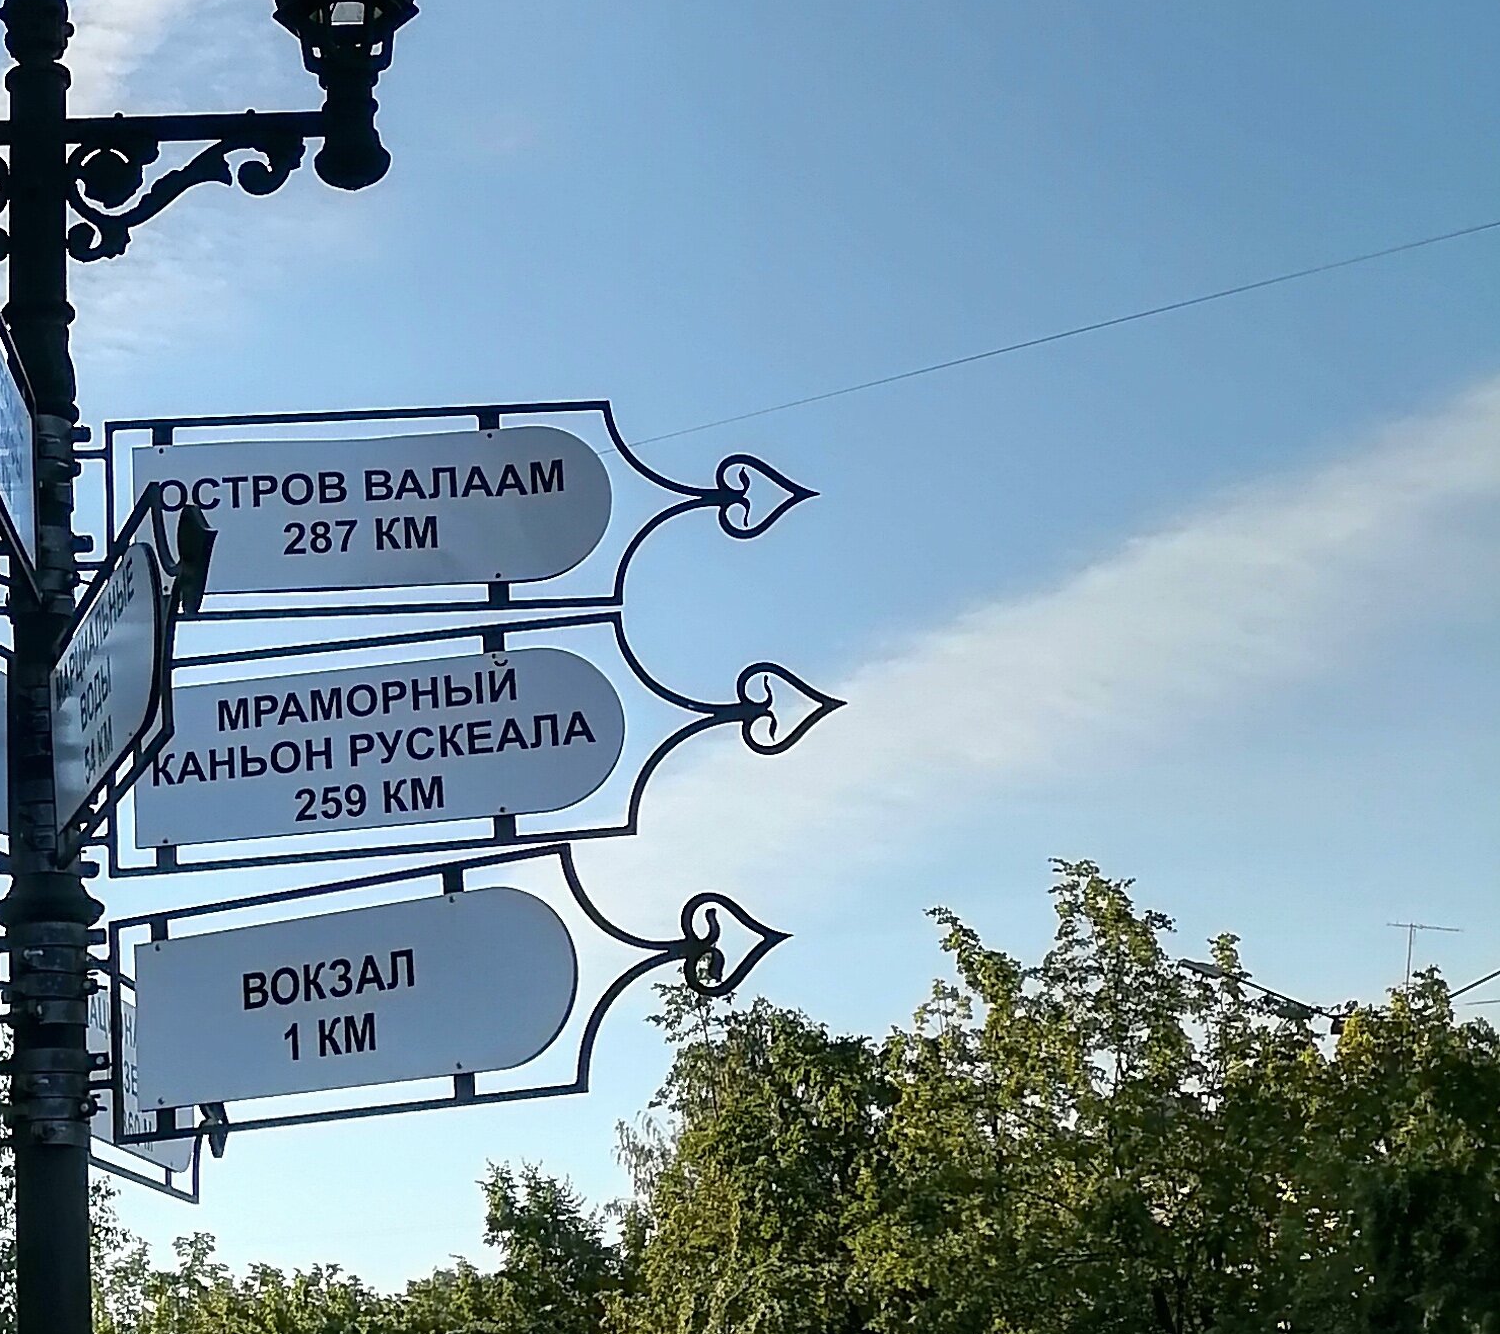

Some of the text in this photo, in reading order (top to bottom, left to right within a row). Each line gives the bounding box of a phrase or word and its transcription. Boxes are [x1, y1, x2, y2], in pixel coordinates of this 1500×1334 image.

[157, 459, 564, 512] ОСТРОВ ВАЛААМ
[284, 516, 438, 555] 287 КМ
[56, 556, 134, 710] МАРЦИАЛЬНЫЕ
[79, 656, 112, 732] ВОДЫ
[218, 658, 517, 731] МРАМОРНЫЙ
[84, 715, 113, 784] 54 КМ
[152, 711, 596, 786] КАНЬОН РУСКЕАЛА
[295, 776, 444, 821] 259 КМ
[243, 949, 414, 1010] ВОКЗАЛ
[285, 1013, 376, 1060] 1 КМ
